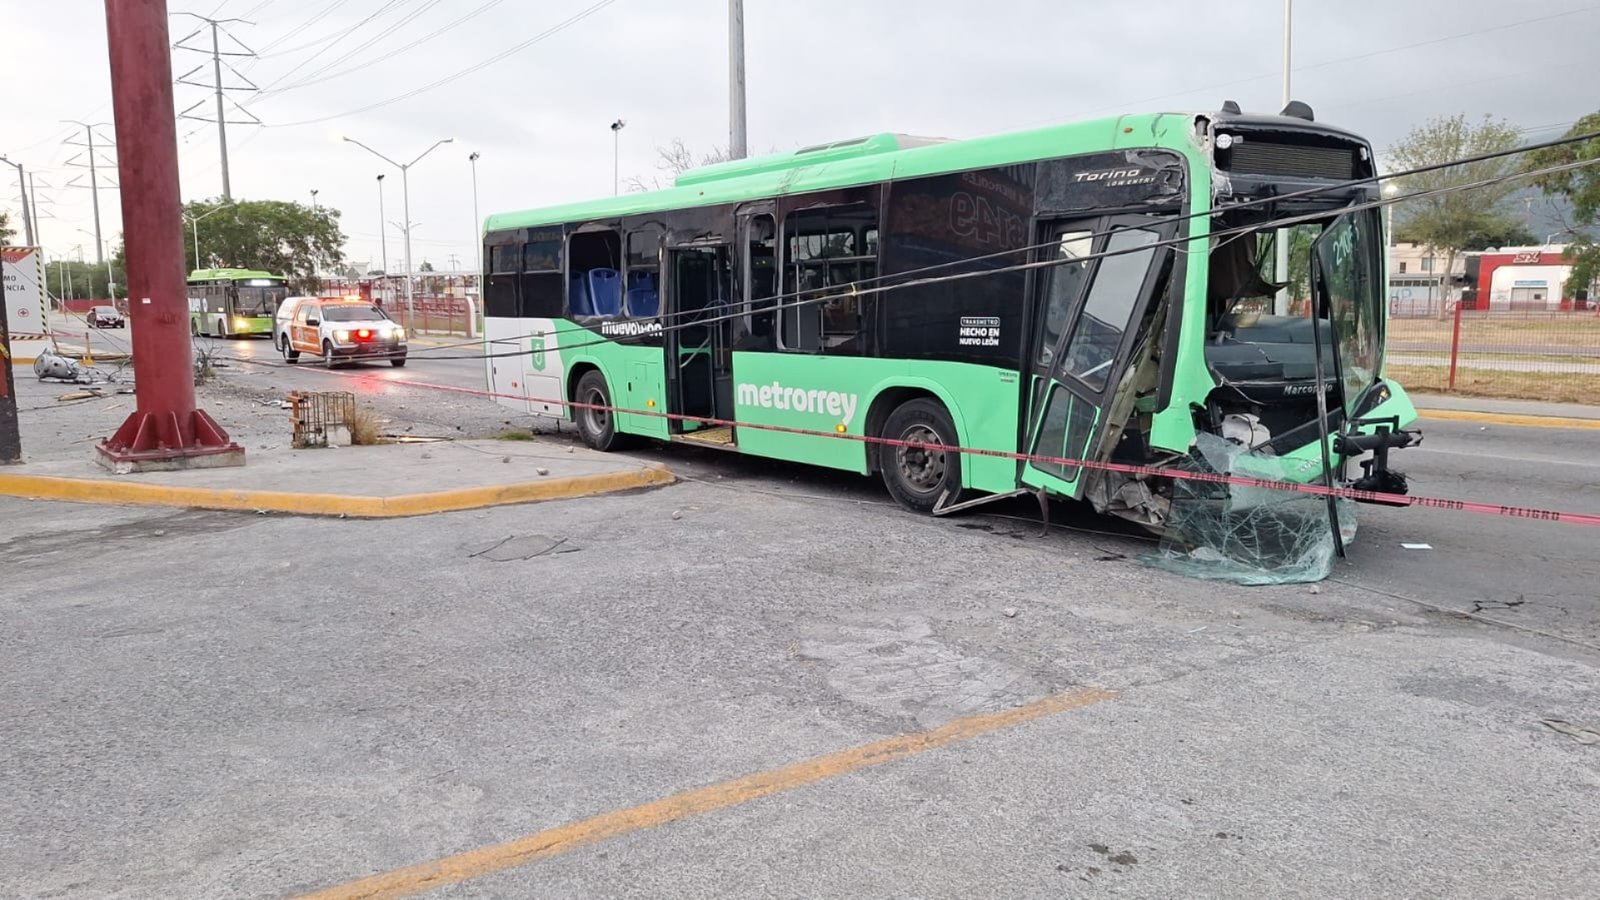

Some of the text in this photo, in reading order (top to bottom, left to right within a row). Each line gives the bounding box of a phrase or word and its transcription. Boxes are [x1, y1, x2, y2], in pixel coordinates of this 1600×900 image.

[1075, 169, 1140, 182] Torino
[1127, 177, 1156, 185] ENTRY
[960, 327, 1000, 337] HECHO EN
[959, 336, 999, 346] NUEVO LEÓN
[738, 381, 857, 426] metrorrey
[1255, 479, 1298, 491] PELIGRO
[1328, 488, 1376, 500] PELIGRO
[1410, 496, 1464, 510] PELIGRO
[1500, 506, 1560, 521] PELIGRO
